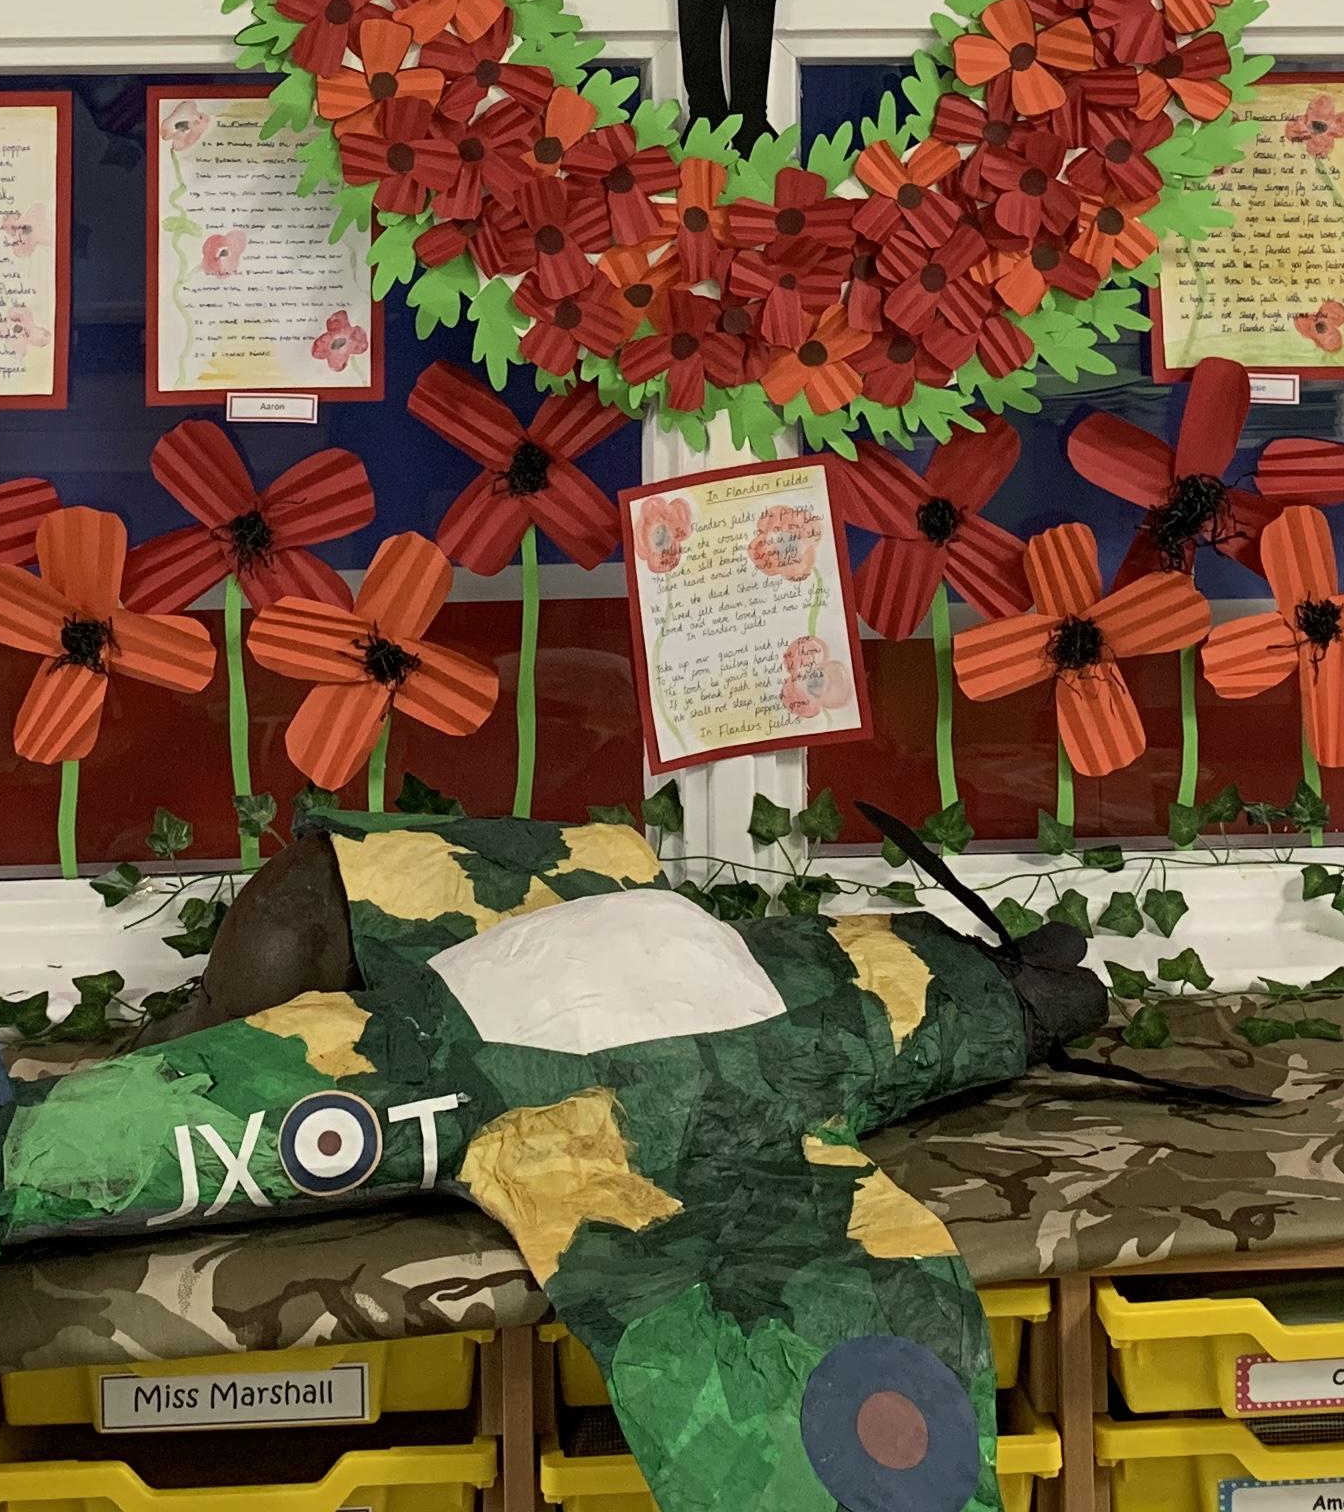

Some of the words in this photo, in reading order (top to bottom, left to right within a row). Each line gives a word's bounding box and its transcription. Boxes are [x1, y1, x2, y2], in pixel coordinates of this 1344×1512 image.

[259, 401, 286, 411] Aaron
[706, 491, 719, 501] In
[727, 482, 769, 497] Flanders
[700, 728, 712, 738] In
[720, 721, 761, 737] Flanders
[147, 1110, 273, 1227] JX
[387, 1093, 459, 1189] T
[134, 1384, 199, 1412] Miss
[210, 1380, 333, 1409] Marshall
